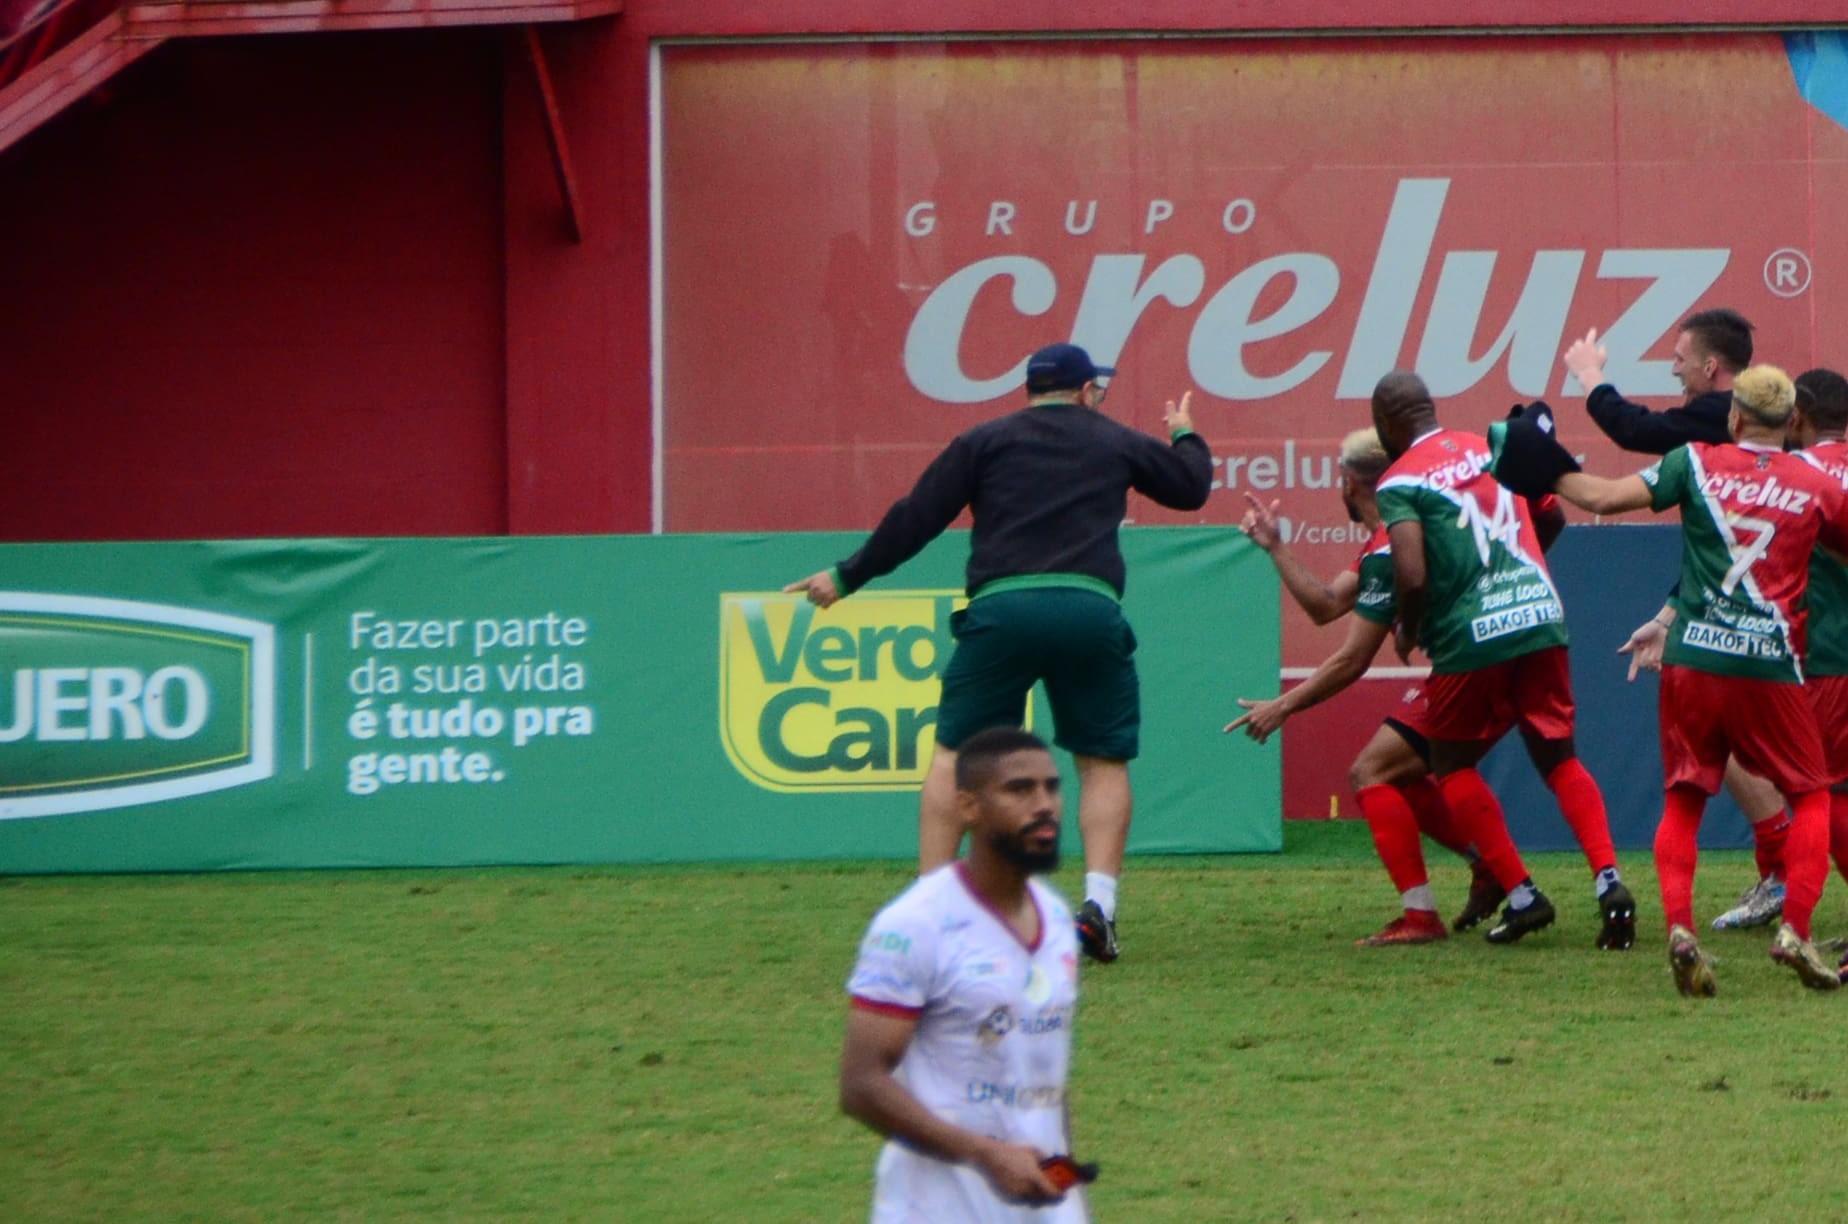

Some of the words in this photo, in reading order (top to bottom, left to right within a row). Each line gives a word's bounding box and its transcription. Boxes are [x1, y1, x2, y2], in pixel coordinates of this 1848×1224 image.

[904, 197, 1258, 238] GRUPO
[901, 177, 1732, 405] creluz
[1427, 448, 1494, 491] crelu
[1702, 475, 1812, 516] creluz
[1457, 482, 1522, 568] 14
[1722, 511, 1775, 597] 7
[350, 612, 464, 651] Fazer
[475, 613, 588, 657] parte
[738, 595, 954, 684] Verd
[1476, 607, 1533, 637] BAKOF
[1687, 621, 1746, 653] BAKOF
[349, 655, 399, 695] da
[413, 662, 486, 694] sua
[499, 653, 585, 692] vida
[348, 697, 379, 739] é
[387, 697, 502, 738] tudo
[514, 704, 594, 746] pra
[757, 686, 938, 773] Car
[347, 746, 505, 795] gente.
